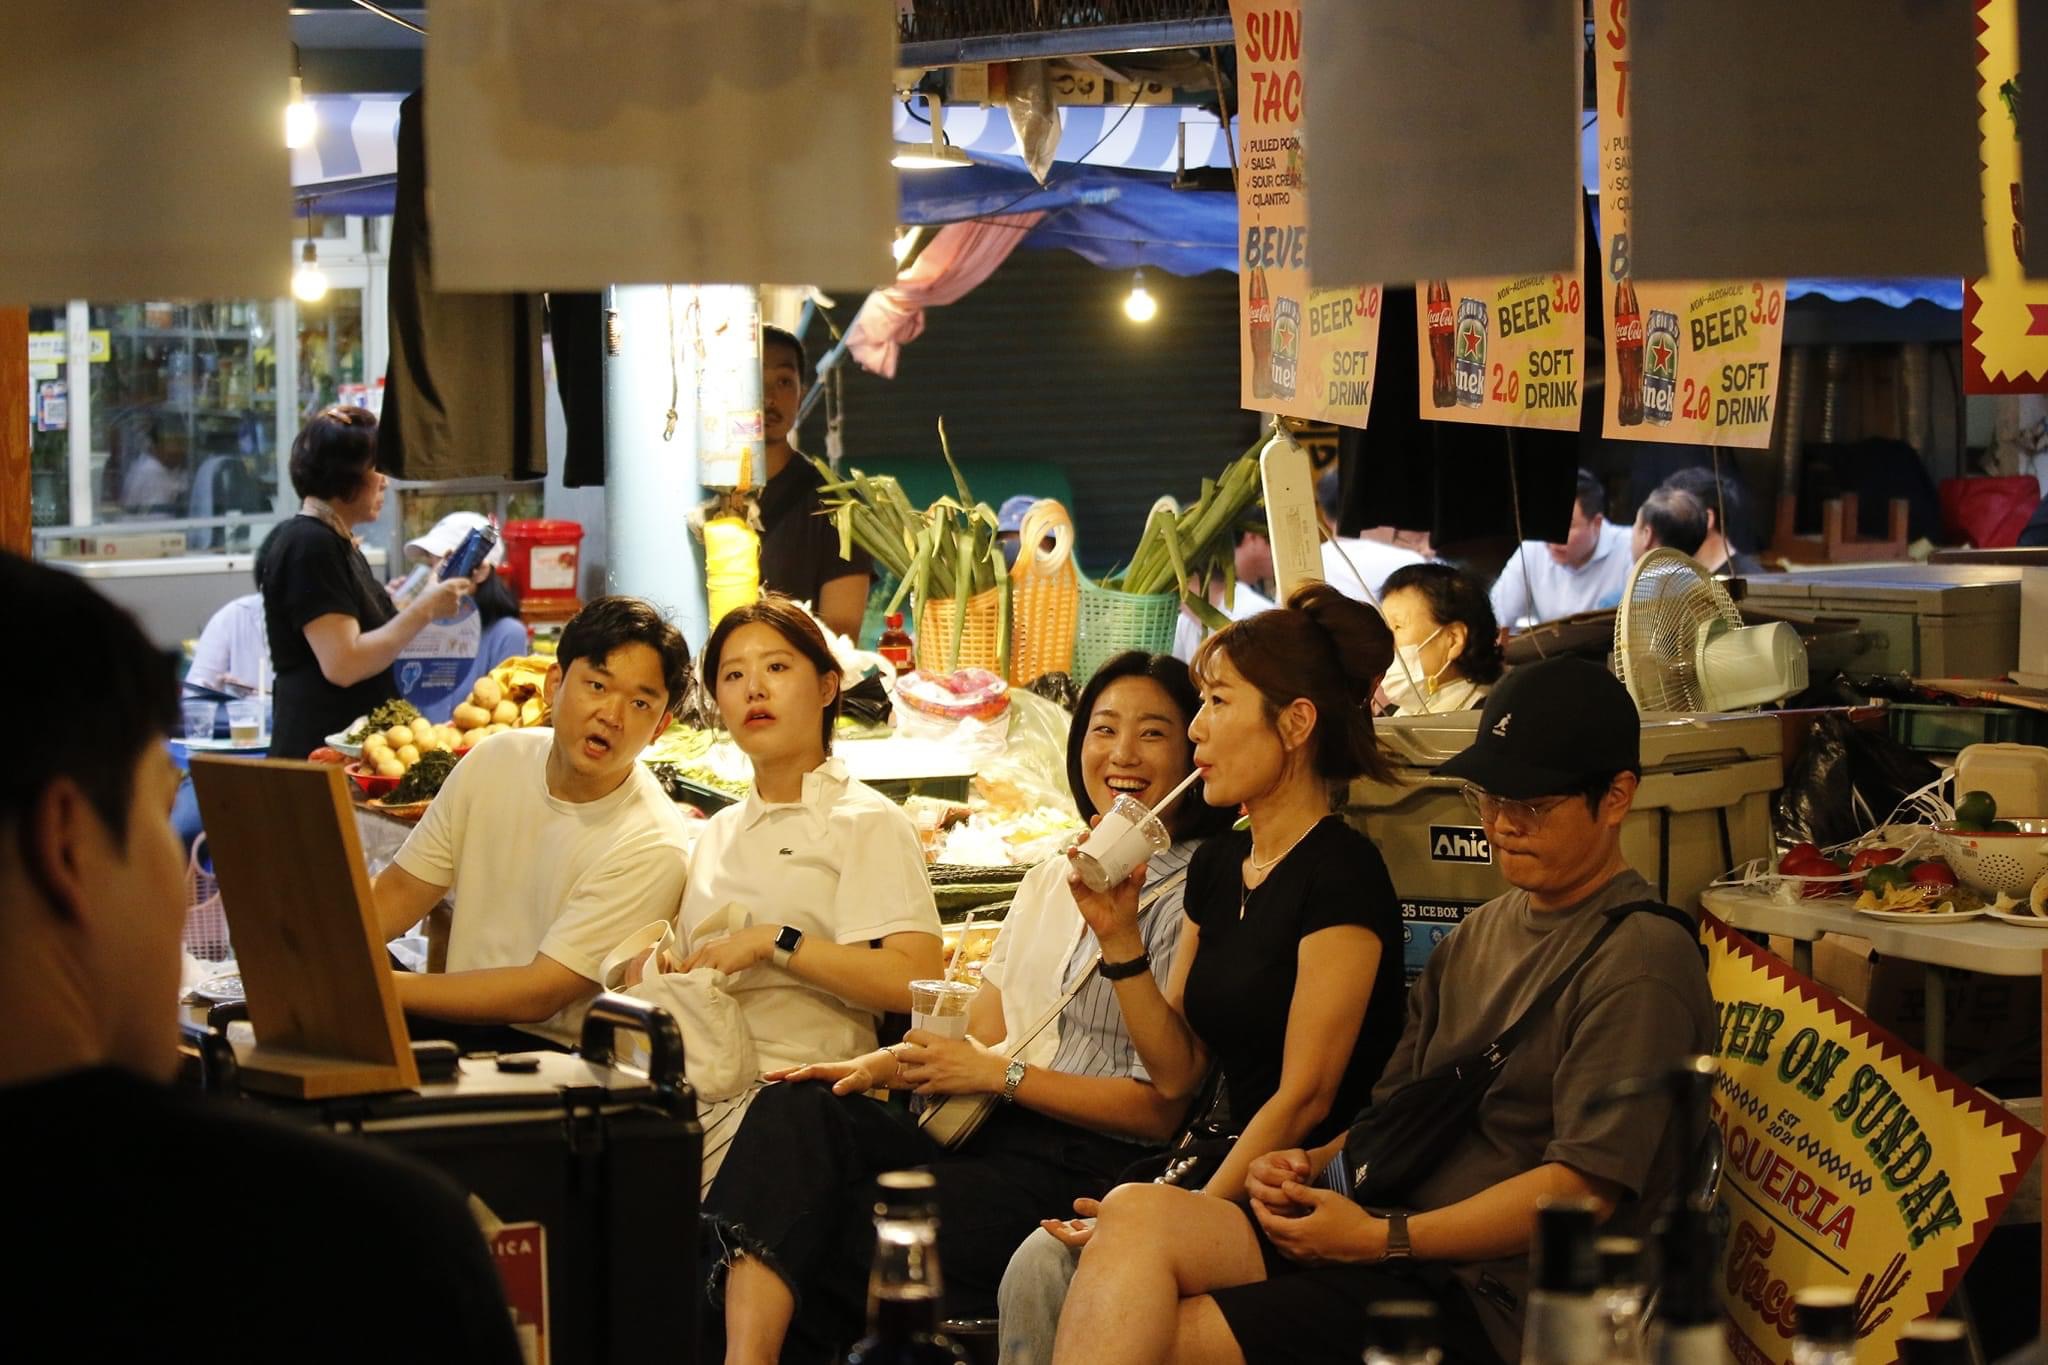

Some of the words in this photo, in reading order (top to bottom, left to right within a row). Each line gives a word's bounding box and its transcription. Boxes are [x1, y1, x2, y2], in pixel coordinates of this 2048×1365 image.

[1245, 9, 1302, 62] SUN
[1250, 139, 1279, 152] PULLED
[1251, 157, 1276, 170] SALSA
[1252, 176, 1273, 189] SOUR
[1245, 225, 1311, 270] BEVE
[1552, 273, 1580, 314] 3.0
[1751, 283, 1780, 325] 3.0
[1309, 298, 1353, 337] BEER
[1498, 294, 1550, 338] BEER
[1691, 304, 1747, 352] BEER
[1332, 351, 1369, 376] SOFT
[1529, 349, 1575, 378] SOFT
[1722, 363, 1769, 392] SOFT
[1328, 381, 1369, 406] DRINK
[1492, 363, 1519, 403] 2.0
[1525, 380, 1577, 409] DRINK
[1681, 378, 1711, 421] 2.0
[1716, 395, 1770, 427] DRINK
[1402, 903, 1416, 917] 35
[1419, 905, 1437, 917] ICE
[1437, 907, 1459, 919] BOX
[1765, 1120, 1795, 1147] 2021
[1777, 1109, 1801, 1129] EST
[1777, 1027, 1850, 1102] ON
[1828, 1063, 1963, 1252] SUNDAY
[489, 1239, 533, 1257] ICA
